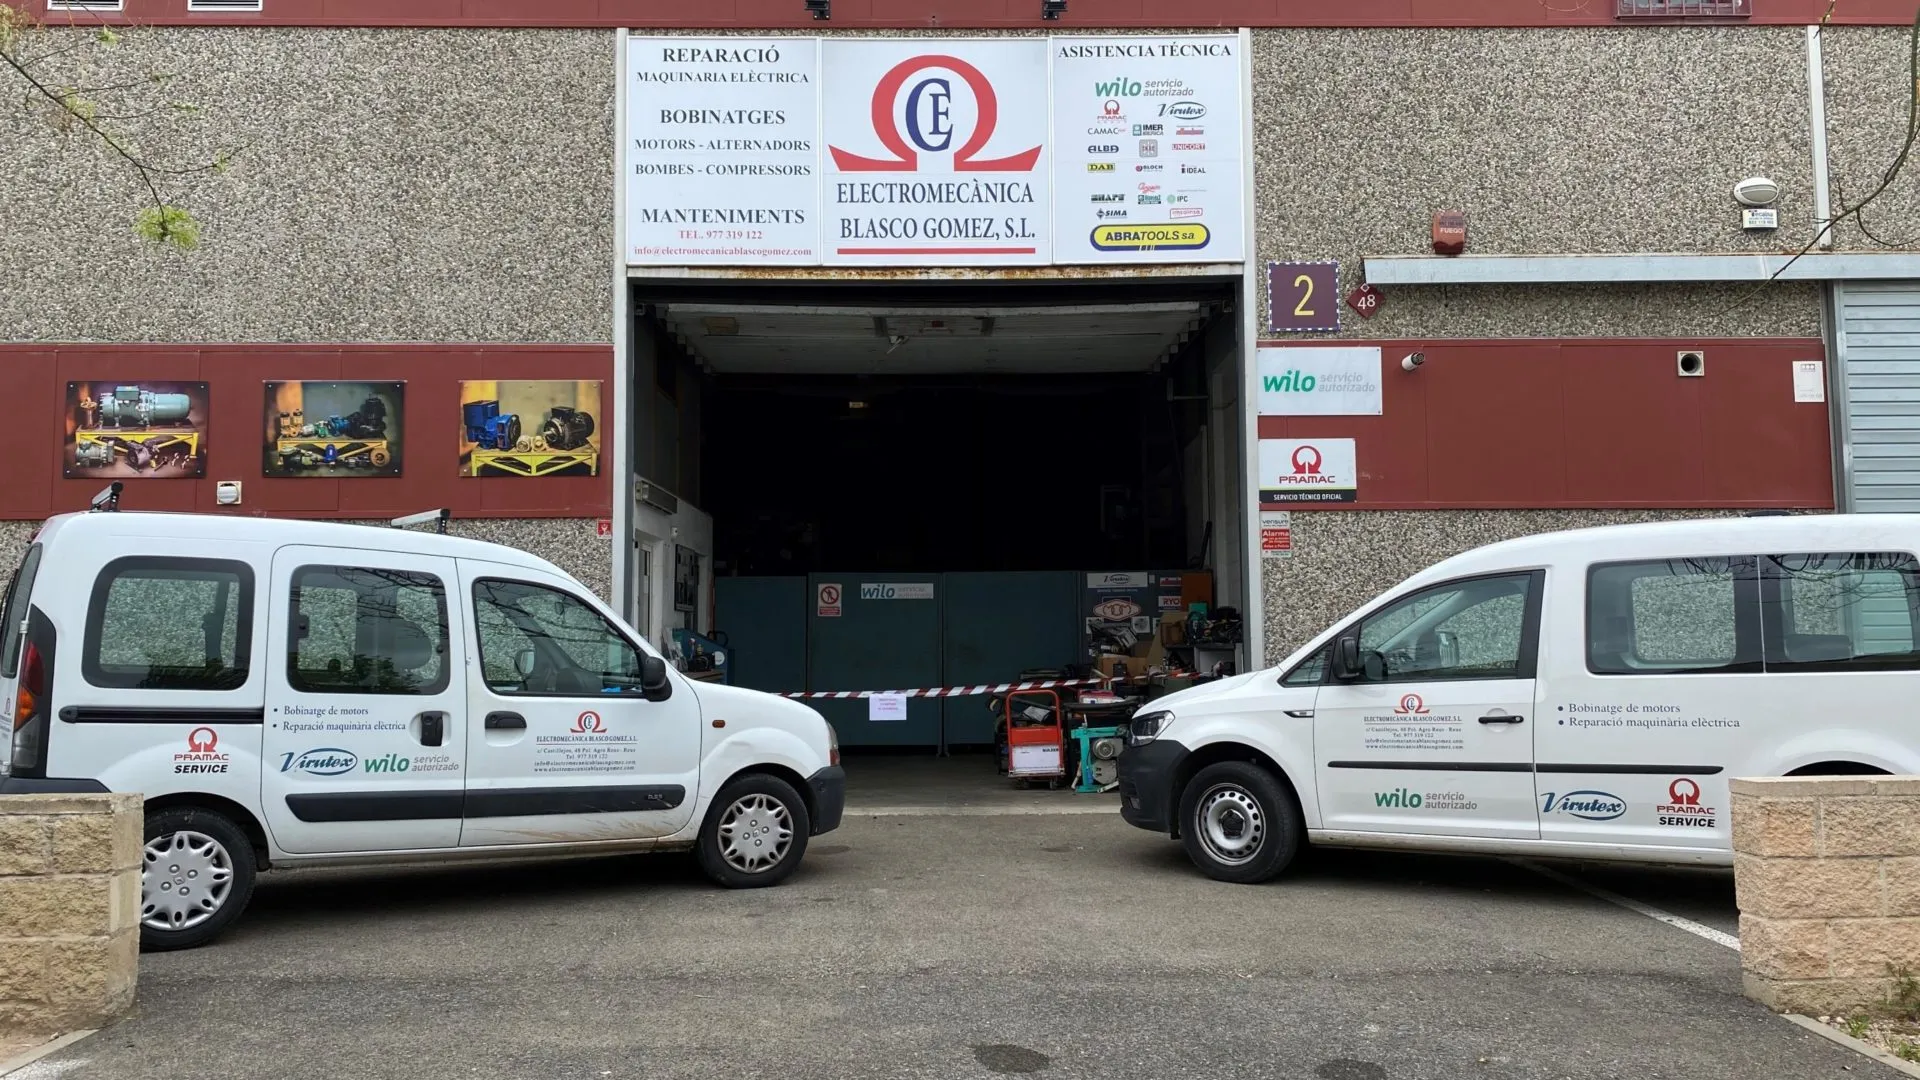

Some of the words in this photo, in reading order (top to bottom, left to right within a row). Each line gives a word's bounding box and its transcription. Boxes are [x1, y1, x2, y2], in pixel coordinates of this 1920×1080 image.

[663, 45, 780, 63] REPARACIÓ
[1058, 45, 1155, 58] ASISTENCIA
[1158, 42, 1232, 57] TÉCNICA
[637, 72, 727, 84] MAQUINARIA
[731, 70, 809, 83] ELÈCTRICA
[1095, 77, 1142, 97] wilo
[1145, 79, 1183, 88] servicio
[1143, 88, 1194, 97] autorizado
[660, 109, 786, 125] BOBINATGES
[1088, 127, 1119, 135] CAMAC
[635, 139, 696, 150] MOTORS
[707, 140, 811, 151] ALTERNADORS
[635, 164, 694, 175] BOMBES
[706, 165, 811, 176] COMPRESSORS
[837, 179, 1034, 204] ELECTROMECÀNICA
[642, 208, 805, 224] MANTENIMENTS
[679, 230, 704, 240] TEL.
[706, 230, 723, 239] 977
[726, 230, 743, 239] 319
[746, 230, 762, 239] 122
[840, 218, 918, 239] BLASCO
[923, 218, 1000, 240] GOMEZ,
[1005, 218, 1035, 239] S.L.
[1105, 230, 1180, 242] ABRATOOLS
[635, 246, 812, 257] info@electromecanicablascogomez.com
[1294, 274, 1315, 316] 2
[1358, 294, 1376, 310] 48
[1264, 370, 1316, 393] wilo
[1320, 372, 1363, 382] servicio
[1318, 383, 1376, 392] autorizado
[1279, 476, 1336, 484] PRAMAC
[862, 584, 896, 598] wilo
[284, 706, 329, 717] Bobinatge
[330, 706, 339, 715] de
[340, 707, 369, 715] motors
[1569, 703, 1623, 715] Bobinatge
[1626, 703, 1639, 713] de
[1642, 704, 1681, 713] motors
[283, 721, 325, 732] Reparació
[326, 721, 372, 733] maquinària
[374, 721, 406, 731] elèctrica
[1569, 717, 1623, 728] Reparació
[1626, 717, 1688, 729] maquinària
[1691, 717, 1741, 728] elèctrica
[174, 753, 229, 761] PRAMAC
[280, 750, 357, 773] Virutex
[364, 753, 410, 773] wilo
[414, 754, 450, 764] servicio
[174, 764, 229, 774] SERVICE
[411, 762, 459, 772] autorizado
[1375, 788, 1422, 808] wilo
[1425, 792, 1465, 800] servicio
[1540, 791, 1624, 814] Virutex
[1424, 801, 1478, 810] autorizado
[1657, 805, 1716, 815] PRAMAC
[1659, 816, 1716, 828] SERVICE
